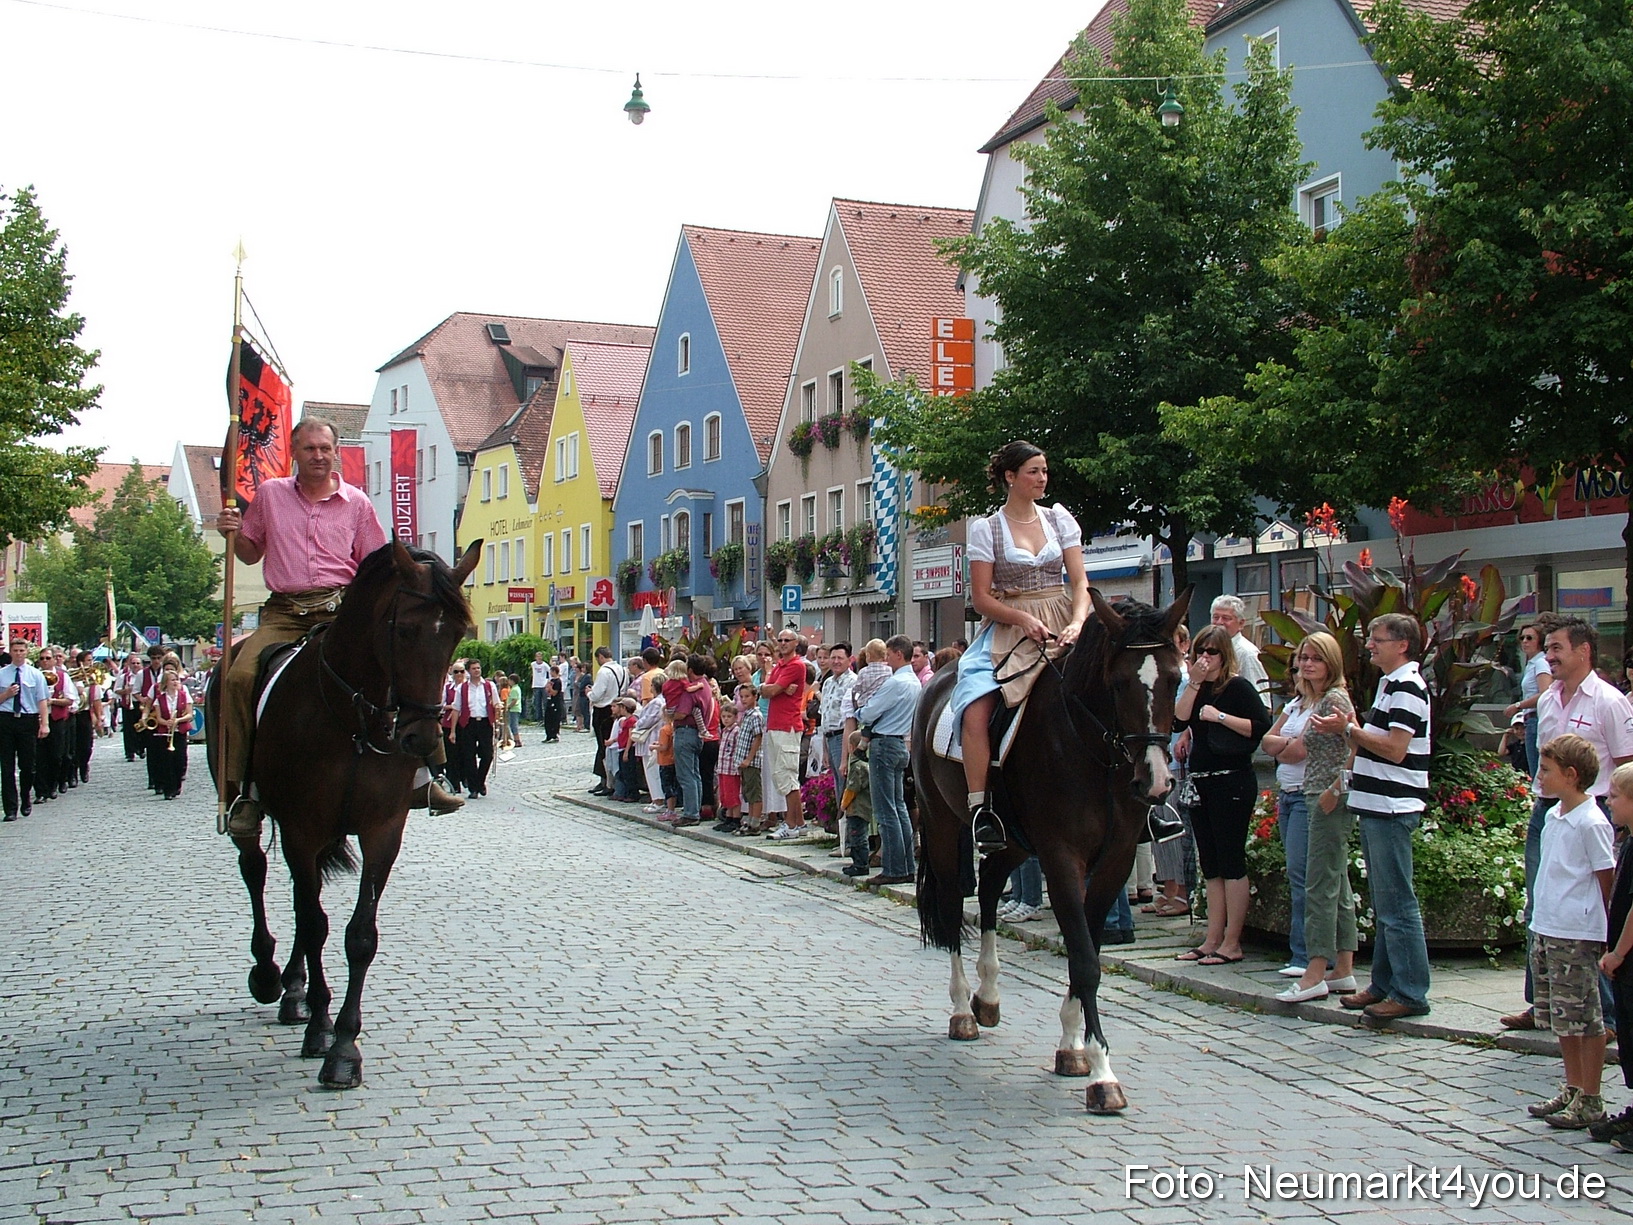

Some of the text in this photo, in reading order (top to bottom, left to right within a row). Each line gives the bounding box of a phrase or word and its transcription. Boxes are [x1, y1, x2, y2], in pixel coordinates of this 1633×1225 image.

[490, 519, 508, 536] HOTEL
[747, 536, 758, 589] WITTL
[954, 546, 962, 594] KINO
[488, 602, 513, 613] Restaurant
[786, 588, 797, 609] P
